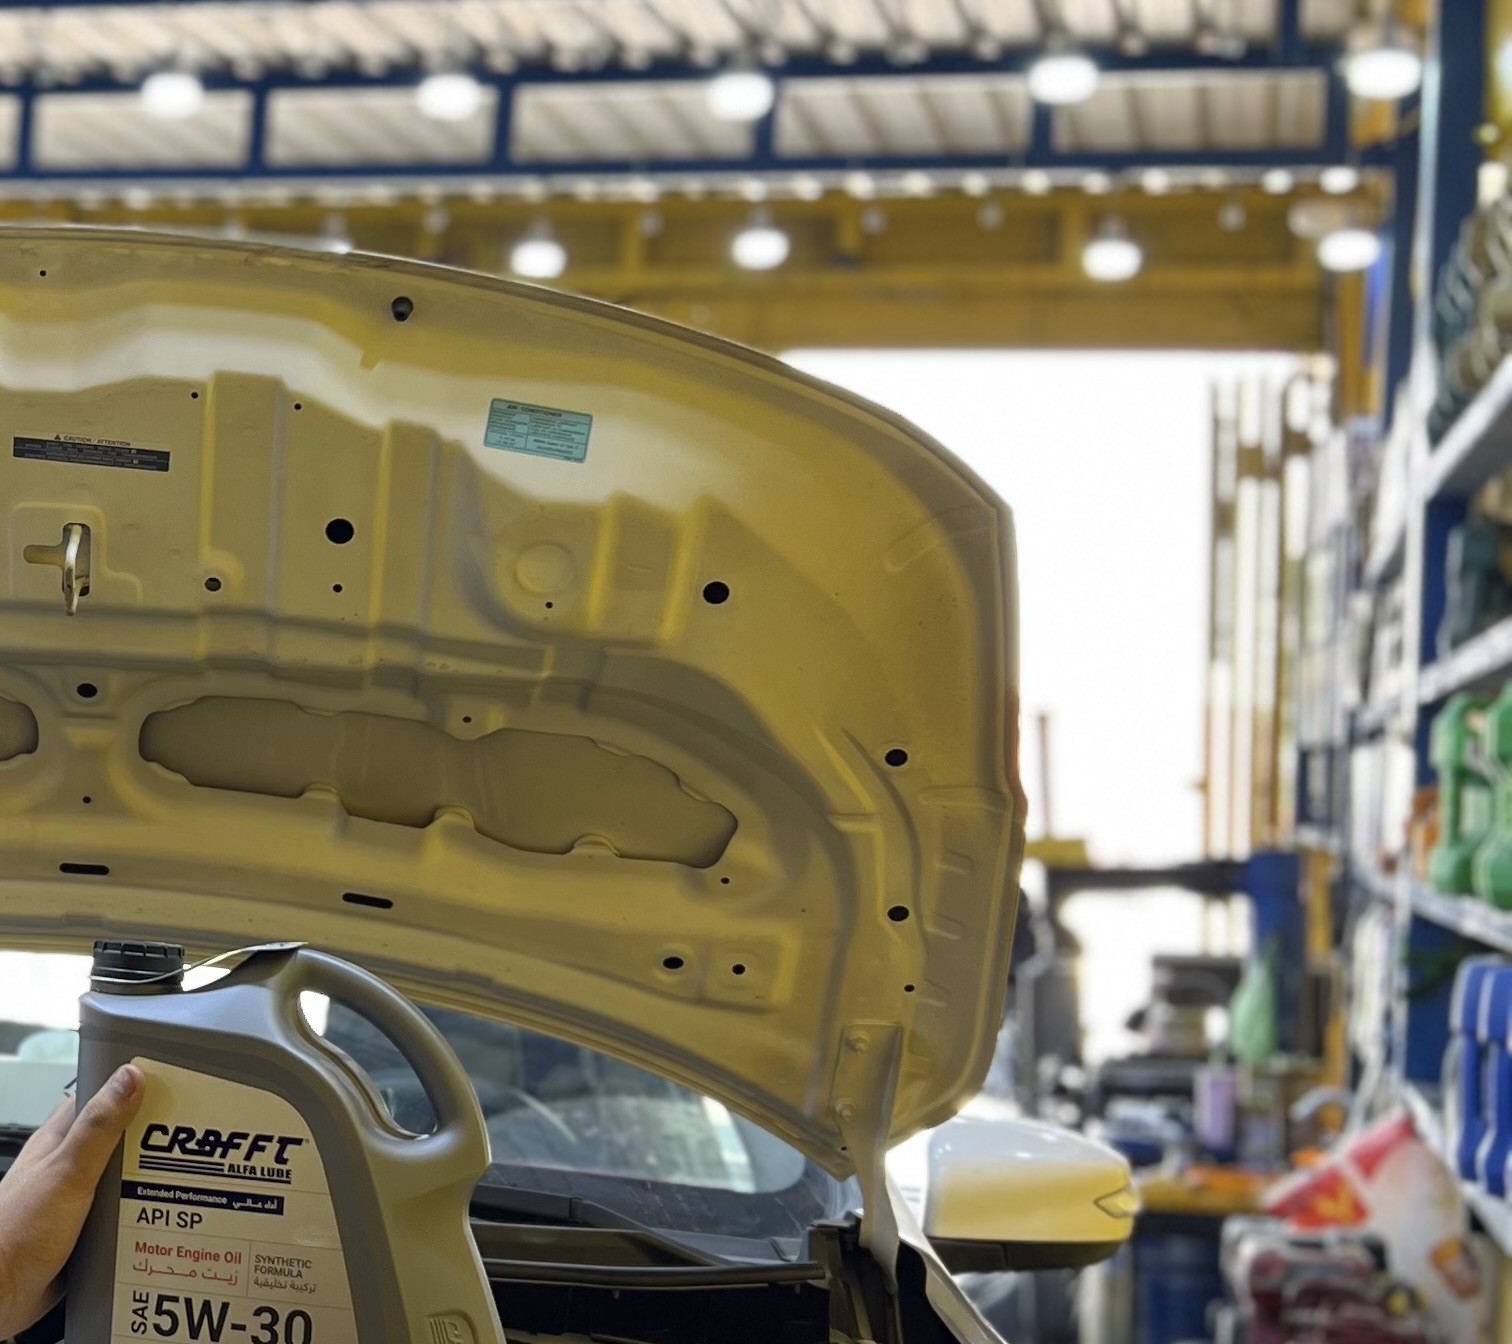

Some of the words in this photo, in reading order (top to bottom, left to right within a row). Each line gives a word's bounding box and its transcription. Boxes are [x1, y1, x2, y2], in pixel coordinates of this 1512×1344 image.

[140, 1123, 304, 1165] CRAFFT
[227, 1163, 257, 1176] ALFA
[260, 1166, 292, 1179] LUBE
[137, 1186, 174, 1199] Extended
[175, 1190, 228, 1205] Performance
[136, 1207, 170, 1226] API
[176, 1211, 203, 1229] SP
[135, 1241, 173, 1256] Motor
[176, 1246, 221, 1263] Engine
[224, 1251, 242, 1265] Oil
[254, 1254, 312, 1269] SYNTHETIC
[133, 1258, 197, 1277] محرك
[201, 1267, 238, 1286] زيت
[254, 1264, 303, 1279] FORMULA
[131, 1290, 149, 1335] SAE
